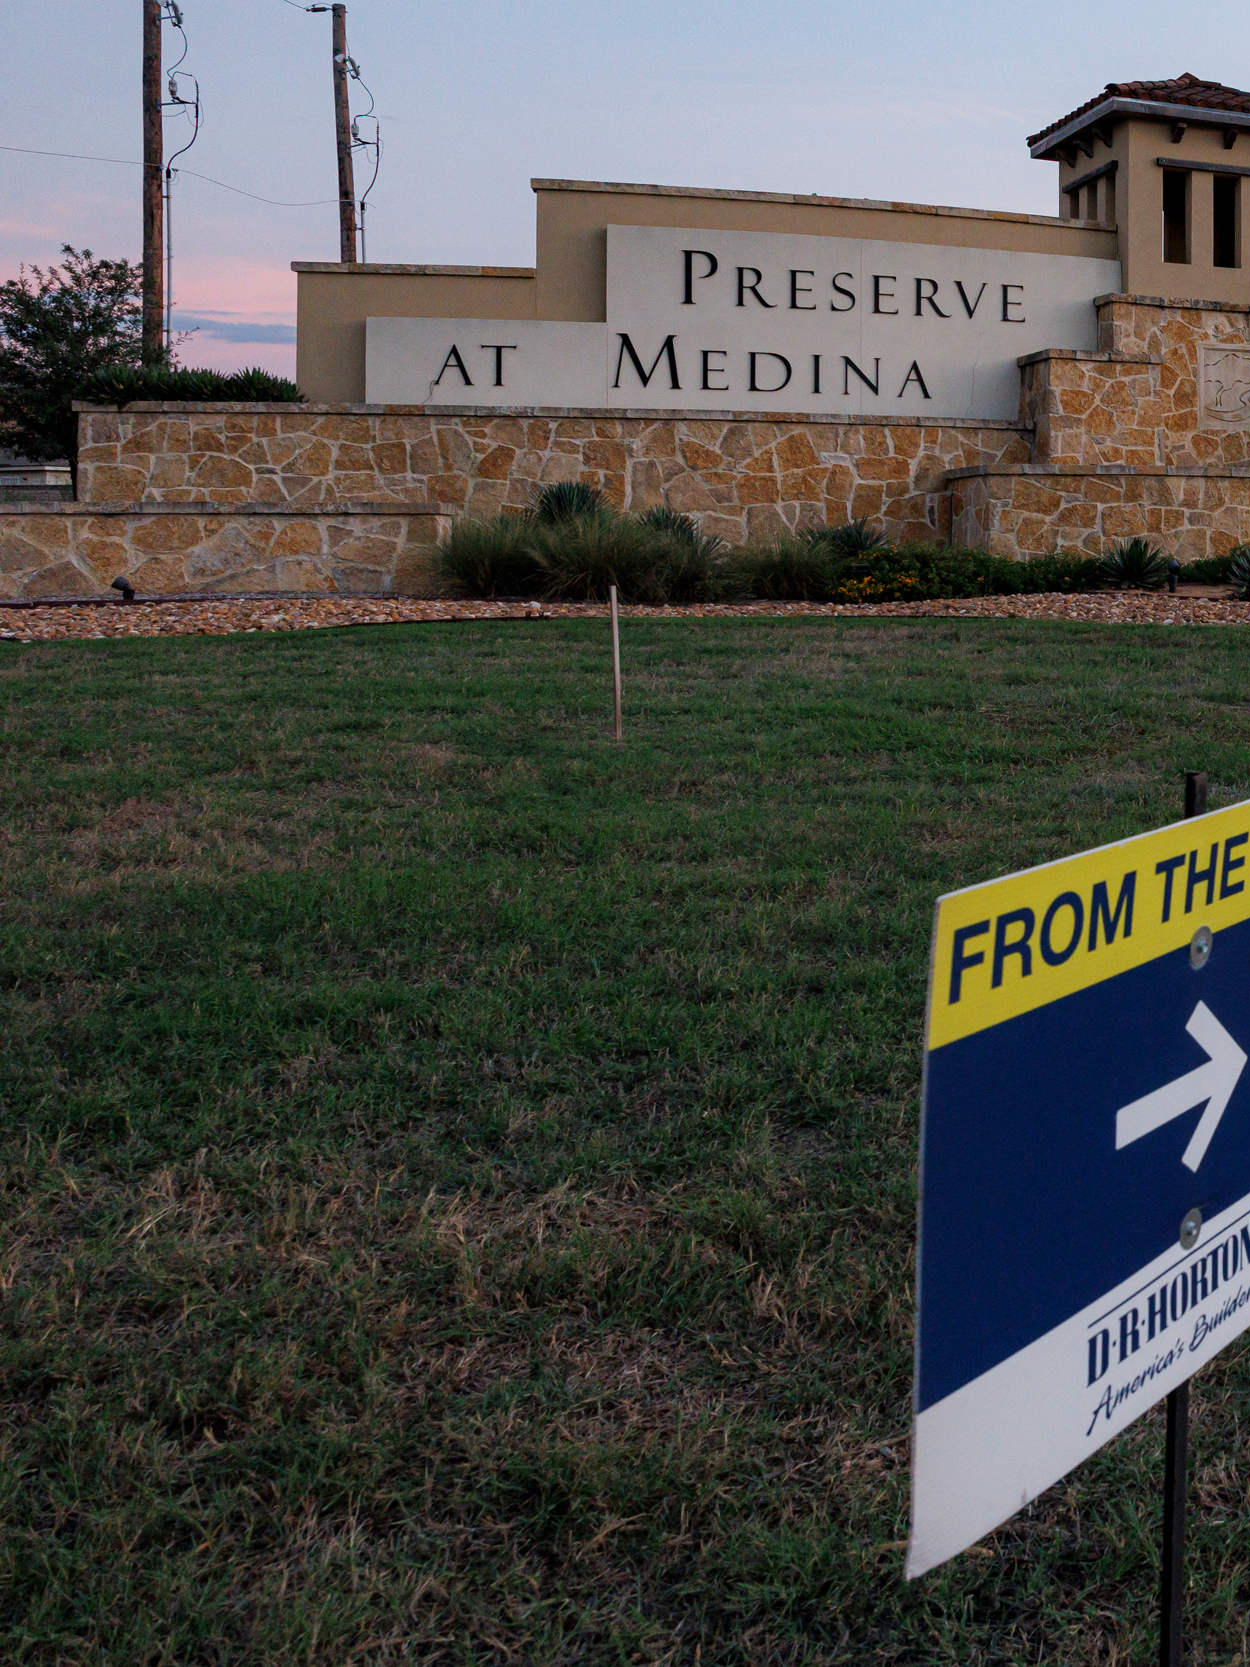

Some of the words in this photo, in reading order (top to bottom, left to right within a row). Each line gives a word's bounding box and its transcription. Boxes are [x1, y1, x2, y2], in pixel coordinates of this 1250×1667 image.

[681, 249, 1026, 323] PRESERVE
[434, 344, 518, 387] AT
[611, 332, 932, 400] MEDINA
[948, 870, 1138, 1006] FROM
[1154, 831, 1250, 924] THE
[1086, 1337, 1184, 1437] America's
